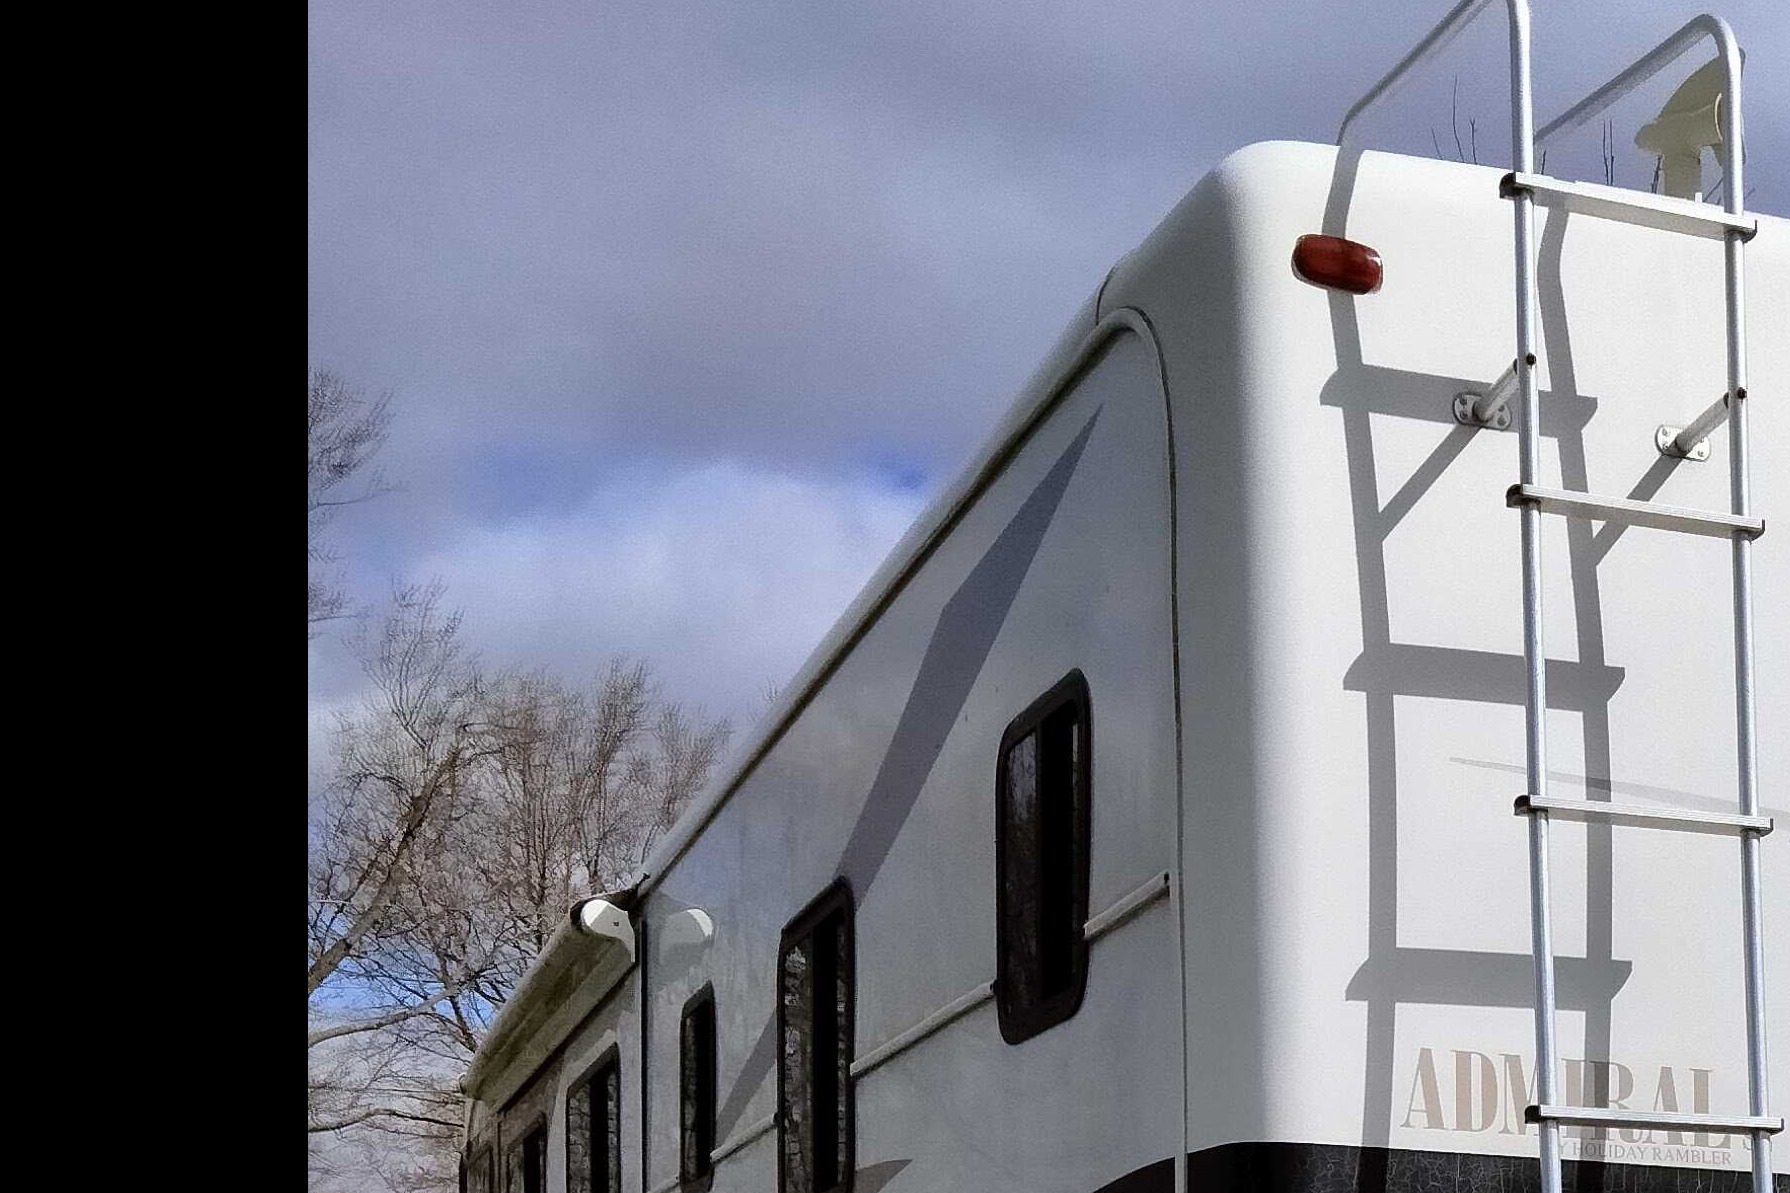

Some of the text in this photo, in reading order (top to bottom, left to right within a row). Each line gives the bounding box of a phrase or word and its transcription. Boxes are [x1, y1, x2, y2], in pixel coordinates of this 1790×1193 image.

[1400, 1047, 1732, 1150] ADMIRAL
[1572, 1141, 1649, 1160] HOLIDAY
[1651, 1147, 1733, 1166] RAMBLER
